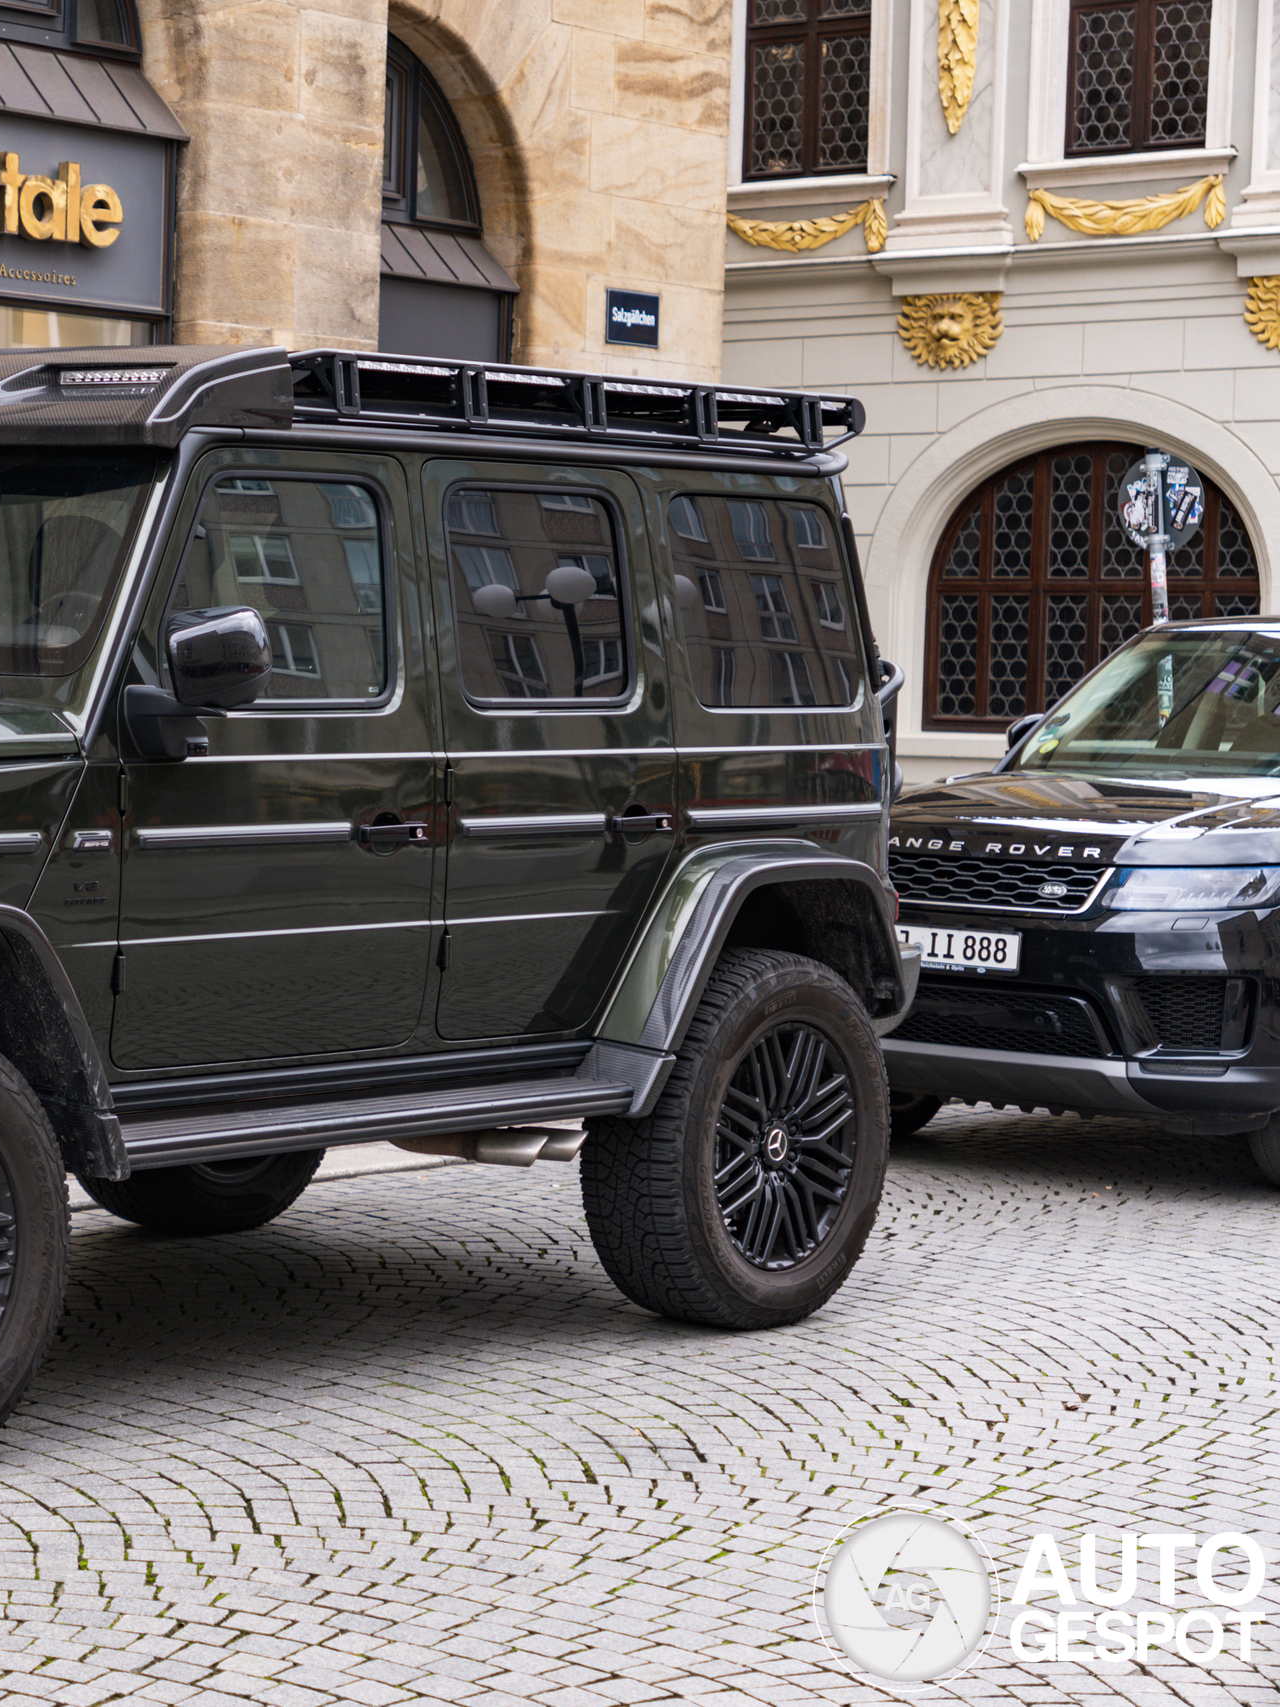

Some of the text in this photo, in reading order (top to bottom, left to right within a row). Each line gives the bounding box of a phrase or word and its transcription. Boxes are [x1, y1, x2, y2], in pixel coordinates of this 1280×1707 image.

[611, 306, 656, 327] Salzgäßchen
[889, 836, 1102, 859] ANGE ROVER
[73, 880, 99, 893] V8
[927, 932, 955, 959] II
[962, 935, 1008, 964] 888
[846, 1018, 884, 1130] PIRELLI
